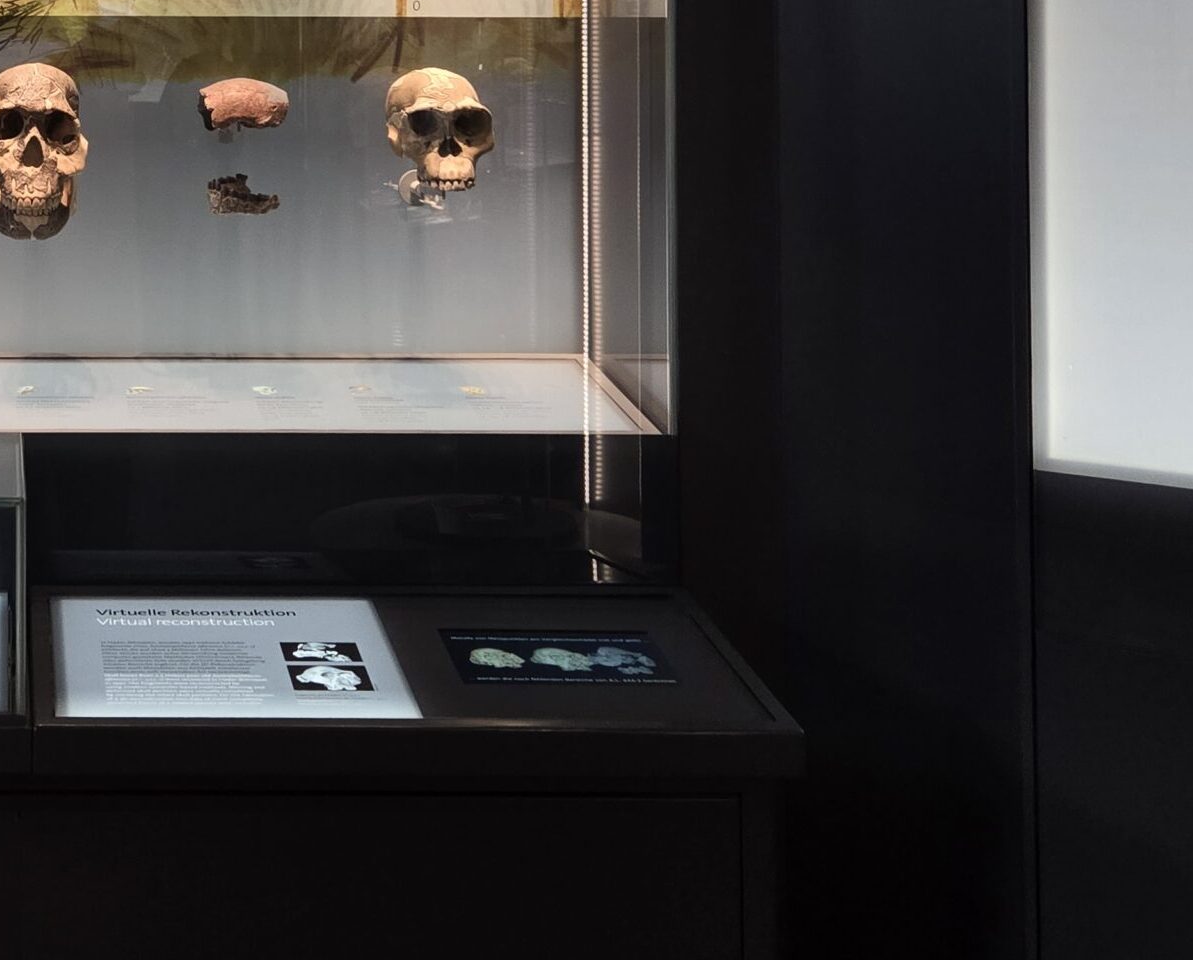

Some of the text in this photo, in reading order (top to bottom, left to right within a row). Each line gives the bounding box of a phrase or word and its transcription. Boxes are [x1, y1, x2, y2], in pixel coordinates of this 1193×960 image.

[412, 0, 421, 12] 0
[96, 608, 297, 617] Virtuelle Rekonstruktion
[96, 617, 276, 627] Virtual reconstruction
